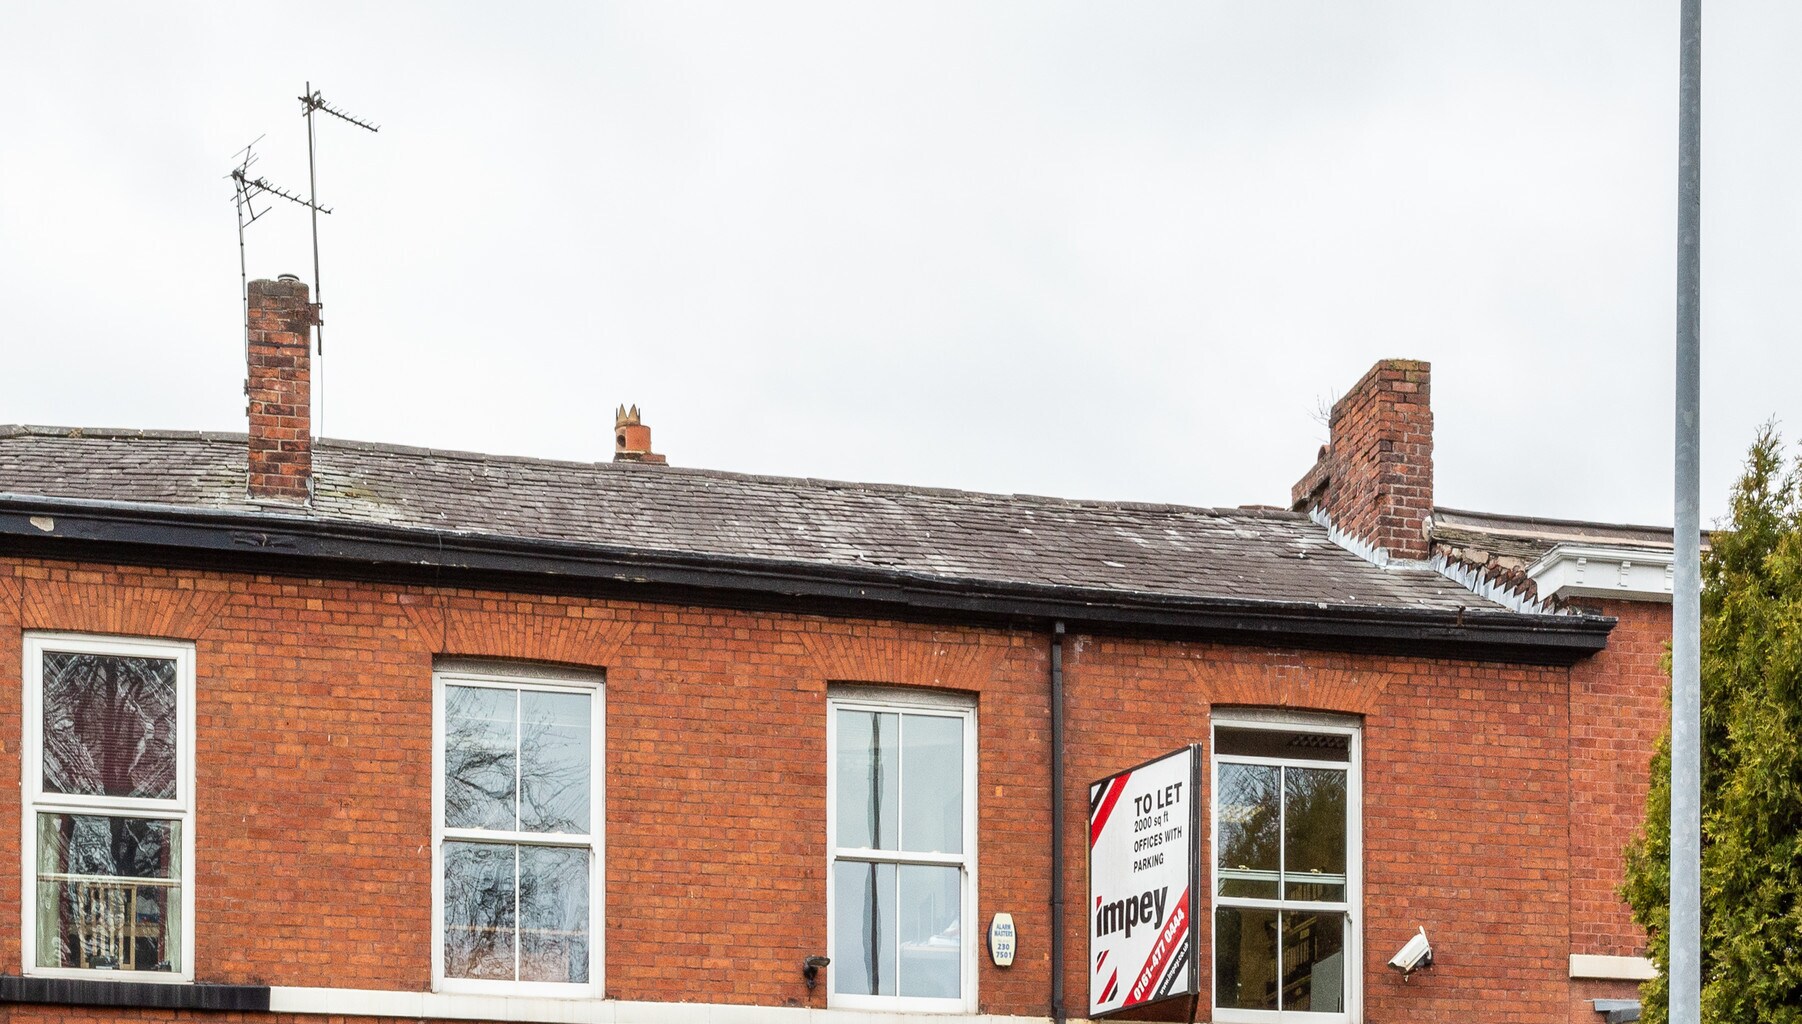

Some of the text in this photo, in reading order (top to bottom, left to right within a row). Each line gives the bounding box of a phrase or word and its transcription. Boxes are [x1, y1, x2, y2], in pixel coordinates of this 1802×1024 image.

[1134, 782, 1182, 817] TO LET
[1134, 810, 1169, 833] 2000 sq ft
[1134, 827, 1182, 853] OFFICES WITH
[1133, 852, 1164, 873] PARKING
[1096, 885, 1169, 939] impey
[1133, 939, 1166, 1001] 0161-477
[1164, 907, 1185, 944] 0444
